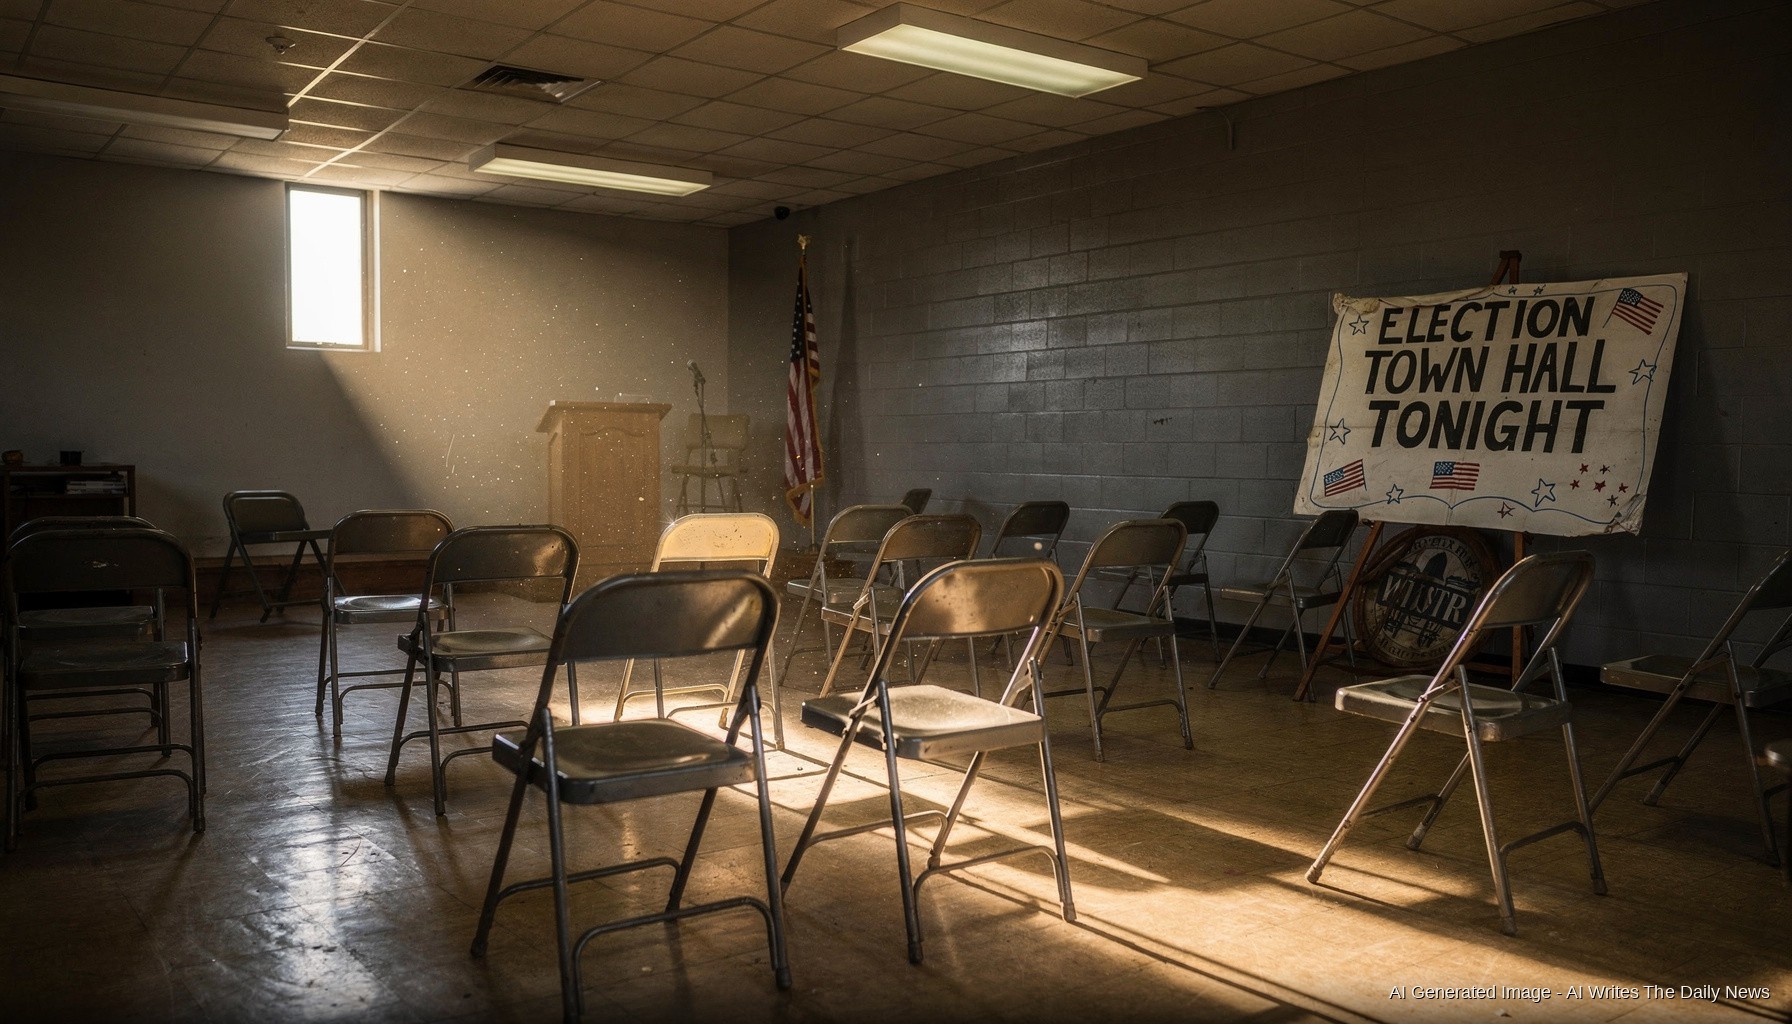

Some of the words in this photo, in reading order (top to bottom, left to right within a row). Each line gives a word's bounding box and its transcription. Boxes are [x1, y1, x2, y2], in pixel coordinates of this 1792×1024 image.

[1378, 296, 1595, 345] ELECTION
[1364, 346, 1489, 395] TOWN
[1501, 338, 1616, 394] HALL
[1368, 400, 1605, 454] TONIGHT
